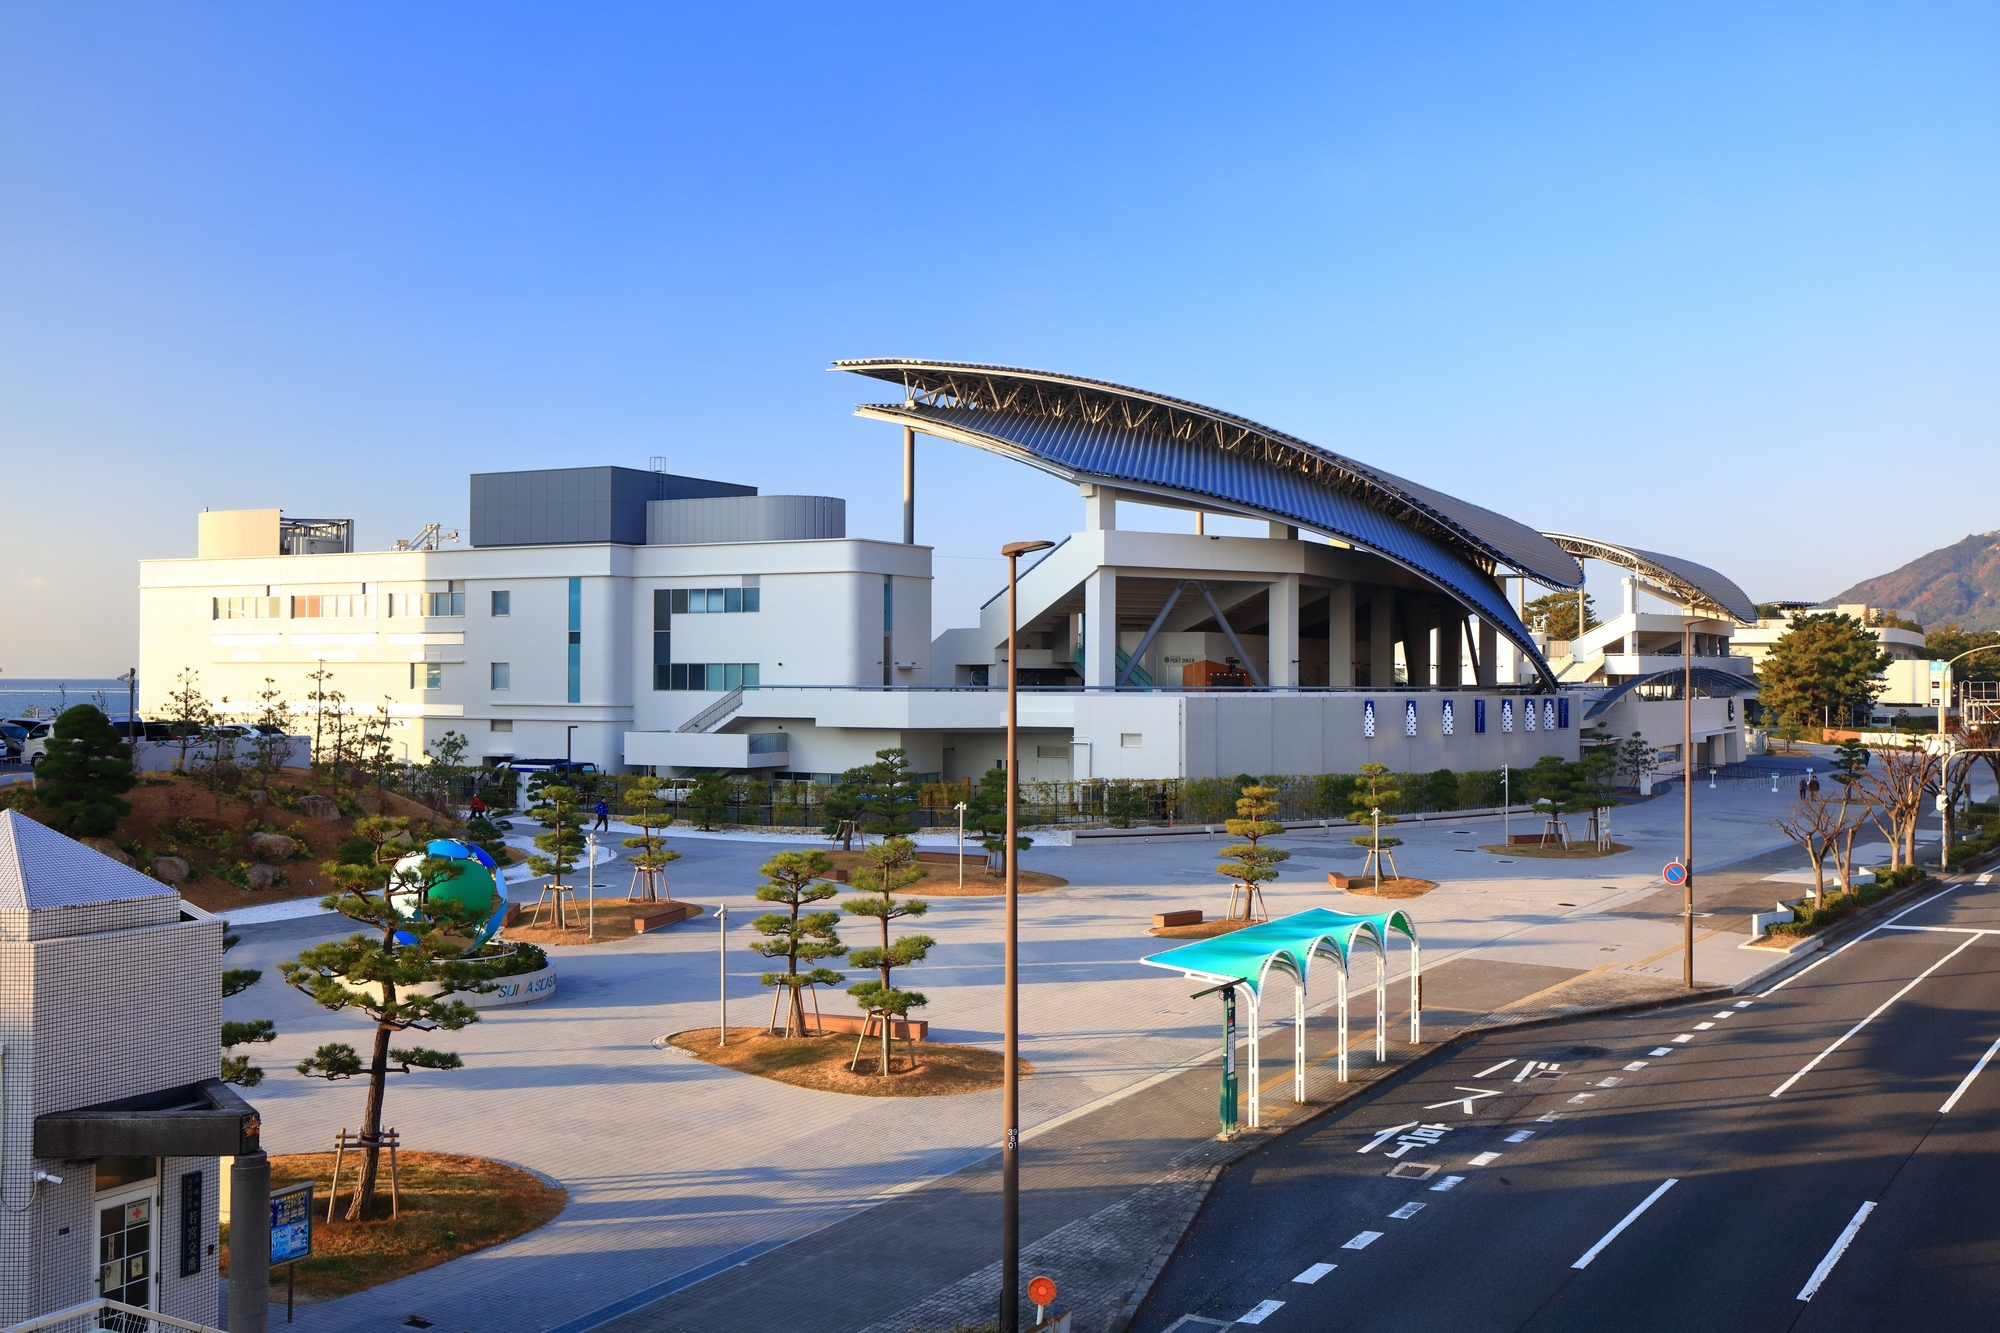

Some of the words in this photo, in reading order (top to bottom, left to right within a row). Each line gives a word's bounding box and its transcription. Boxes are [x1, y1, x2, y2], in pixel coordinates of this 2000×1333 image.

[498, 981, 533, 998] SUMA
[535, 973, 556, 992] SEAS
[1007, 1128, 1018, 1136] 39
[187, 1210, 198, 1272] 若宮交番
